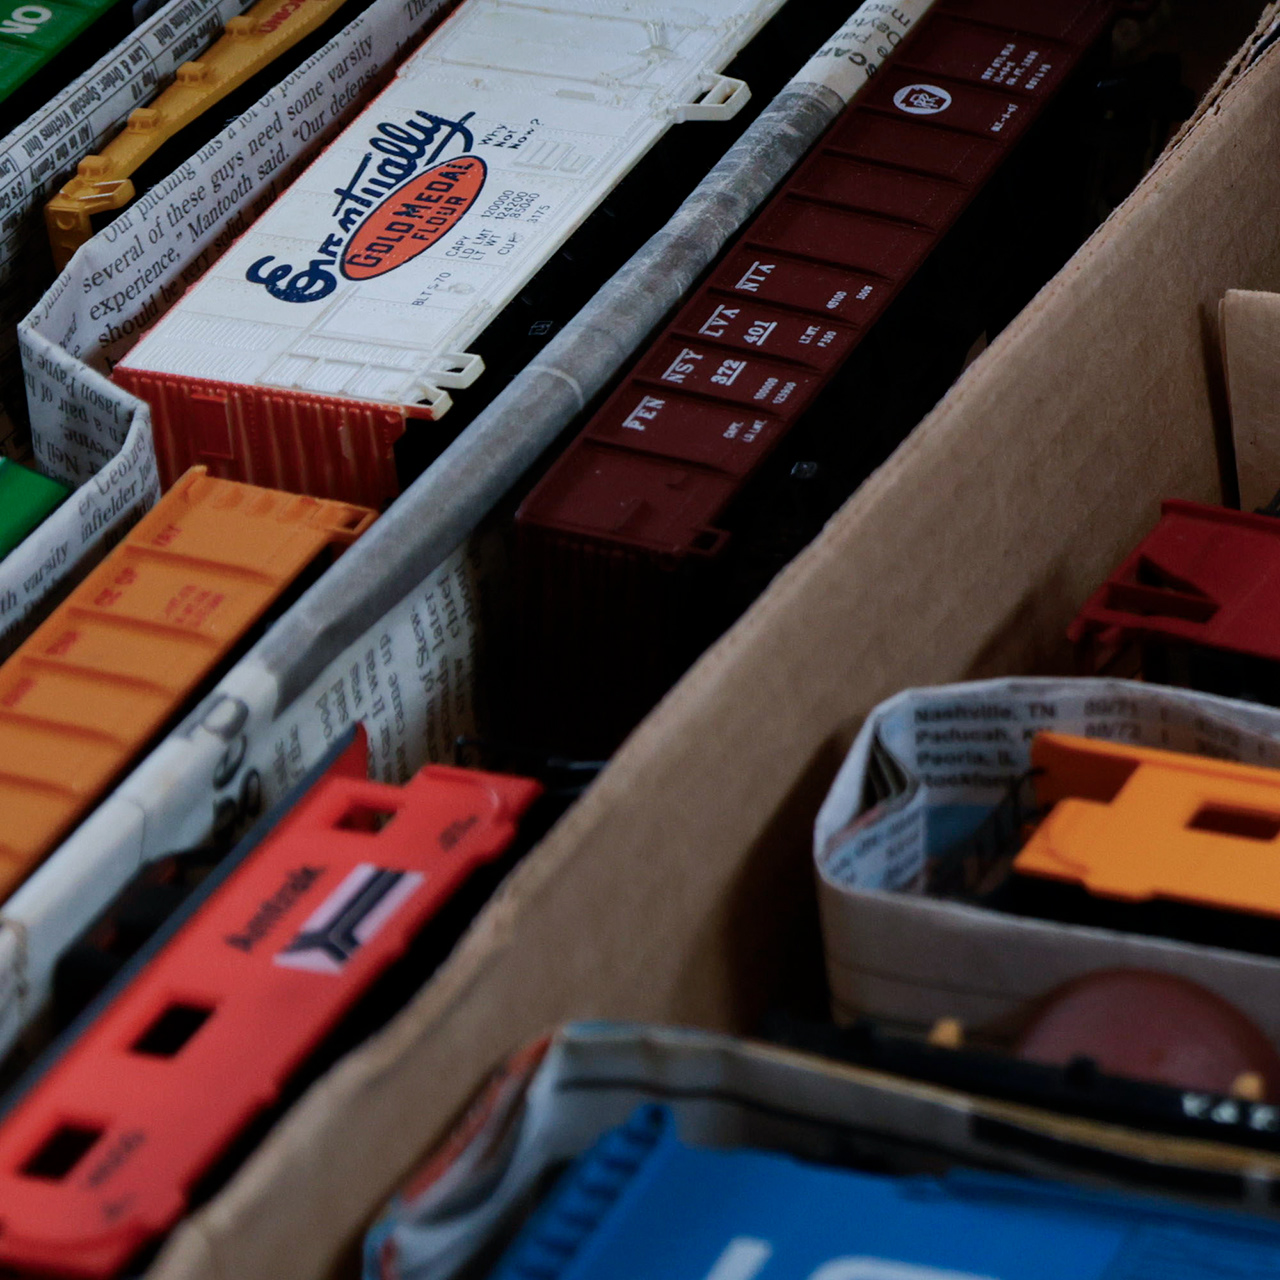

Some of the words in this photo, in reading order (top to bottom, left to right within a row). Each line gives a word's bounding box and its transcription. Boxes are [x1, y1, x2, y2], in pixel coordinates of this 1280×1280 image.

[122, 63, 132, 74] &
[128, 46, 149, 66] Law
[97, 67, 125, 92] Order:
[70, 85, 102, 120] Special
[44, 114, 73, 141] Victims
[78, 124, 91, 143] All
[478, 123, 508, 146] Why
[495, 128, 517, 148] Not
[509, 118, 543, 150] Now?
[22, 136, 44, 158] Unit
[187, 174, 253, 243] Mantooth
[257, 143, 290, 181] said.
[330, 64, 378, 116] defense
[83, 235, 145, 293] several
[148, 216, 164, 244] of
[166, 185, 205, 228] these
[210, 151, 245, 194] guys
[248, 111, 284, 157] need
[287, 81, 323, 121] some
[327, 35, 374, 84] varsity
[246, 110, 475, 303] Eventually
[345, 221, 414, 267] GOLD
[400, 161, 475, 221] MEDAL
[411, 197, 469, 242] FLOUR
[103, 212, 133, 243] Our
[445, 235, 471, 257] CAPY
[481, 190, 514, 218] 120000
[458, 247, 475, 260] LD
[472, 228, 493, 246] LMT
[495, 191, 528, 220] 124200
[471, 250, 486, 261] LT
[484, 234, 501, 247] WT
[509, 192, 540, 218] 85040
[99, 295, 159, 348] should
[160, 281, 178, 304] be
[411, 290, 433, 306] BLT
[37, 355, 76, 398] Payne
[59, 398, 87, 420] pair
[81, 384, 120, 423] Jason
[47, 441, 79, 474] Neil
[23, 541, 68, 593] varsity
[82, 480, 138, 543] infielder
[1028, 703, 1056, 718] TN
